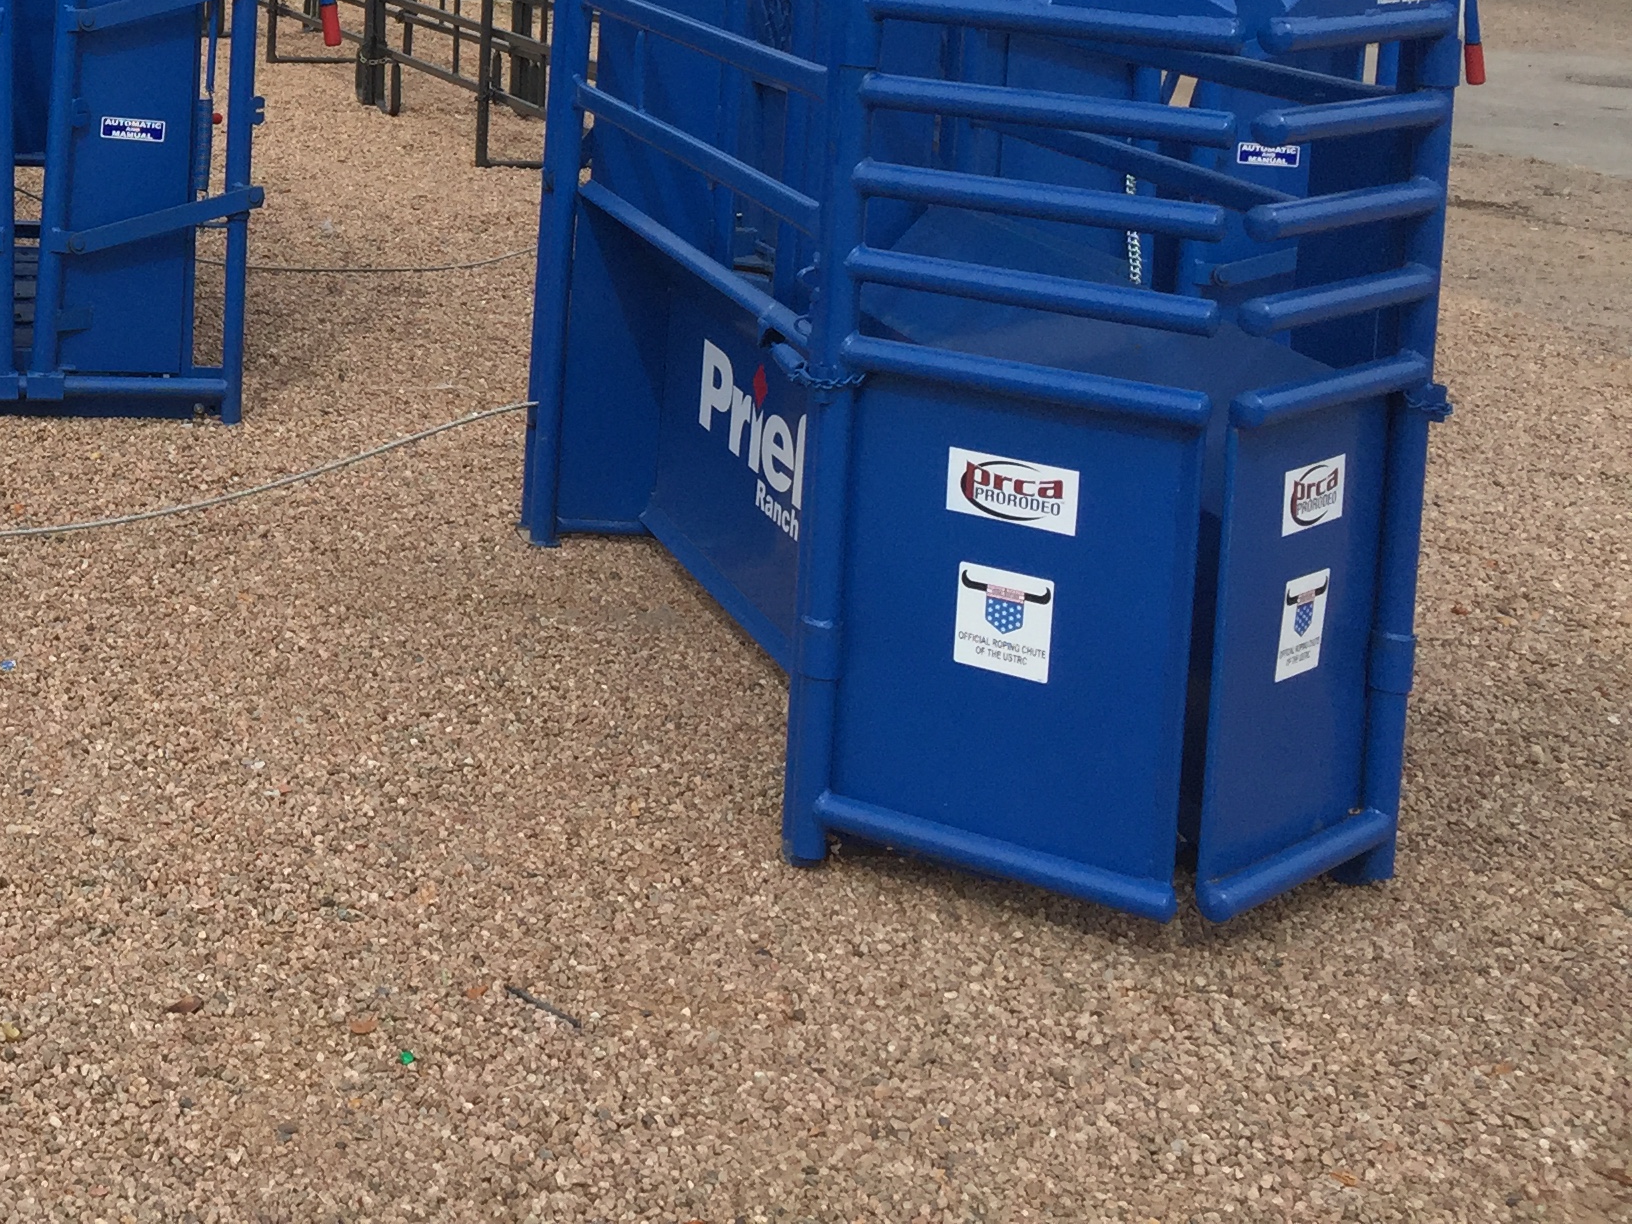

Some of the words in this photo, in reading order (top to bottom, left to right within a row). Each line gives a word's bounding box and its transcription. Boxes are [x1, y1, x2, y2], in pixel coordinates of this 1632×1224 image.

[104, 118, 162, 130] AUTOMATIC
[111, 130, 154, 140] MANUAL
[1241, 144, 1297, 155] AUTOMATIC
[1248, 155, 1288, 165] MANUAL
[965, 459, 1064, 500] prca
[754, 477, 800, 542] Ranch
[974, 486, 1061, 517] PRORODEO
[958, 630, 991, 646] OFFICIAL
[992, 638, 1021, 653] ROPING
[1021, 644, 1047, 660] CHUTE
[975, 645, 986, 655] OF
[987, 648, 1002, 660] THE
[1002, 652, 1028, 666] USTRC
